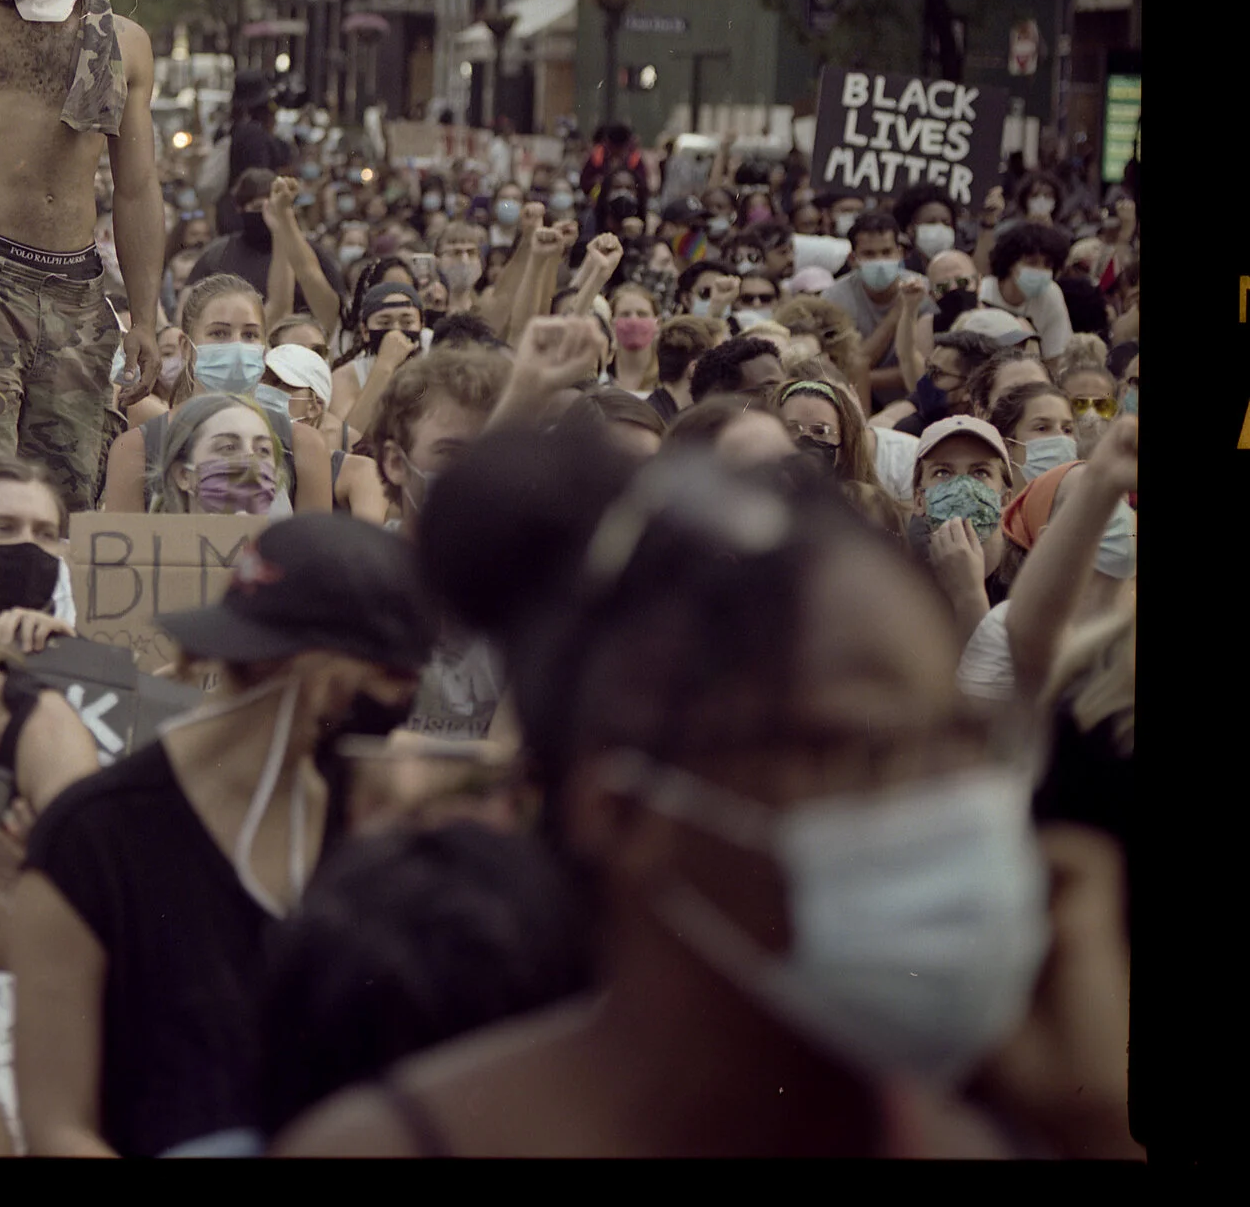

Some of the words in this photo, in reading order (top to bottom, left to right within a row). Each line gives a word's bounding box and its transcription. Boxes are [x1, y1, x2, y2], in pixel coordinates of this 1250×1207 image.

[842, 72, 979, 121] BLACK
[843, 108, 973, 162] LIVES
[824, 147, 973, 204] MATTER
[10, 246, 34, 260] POLO
[34, 254, 63, 266] RALPH
